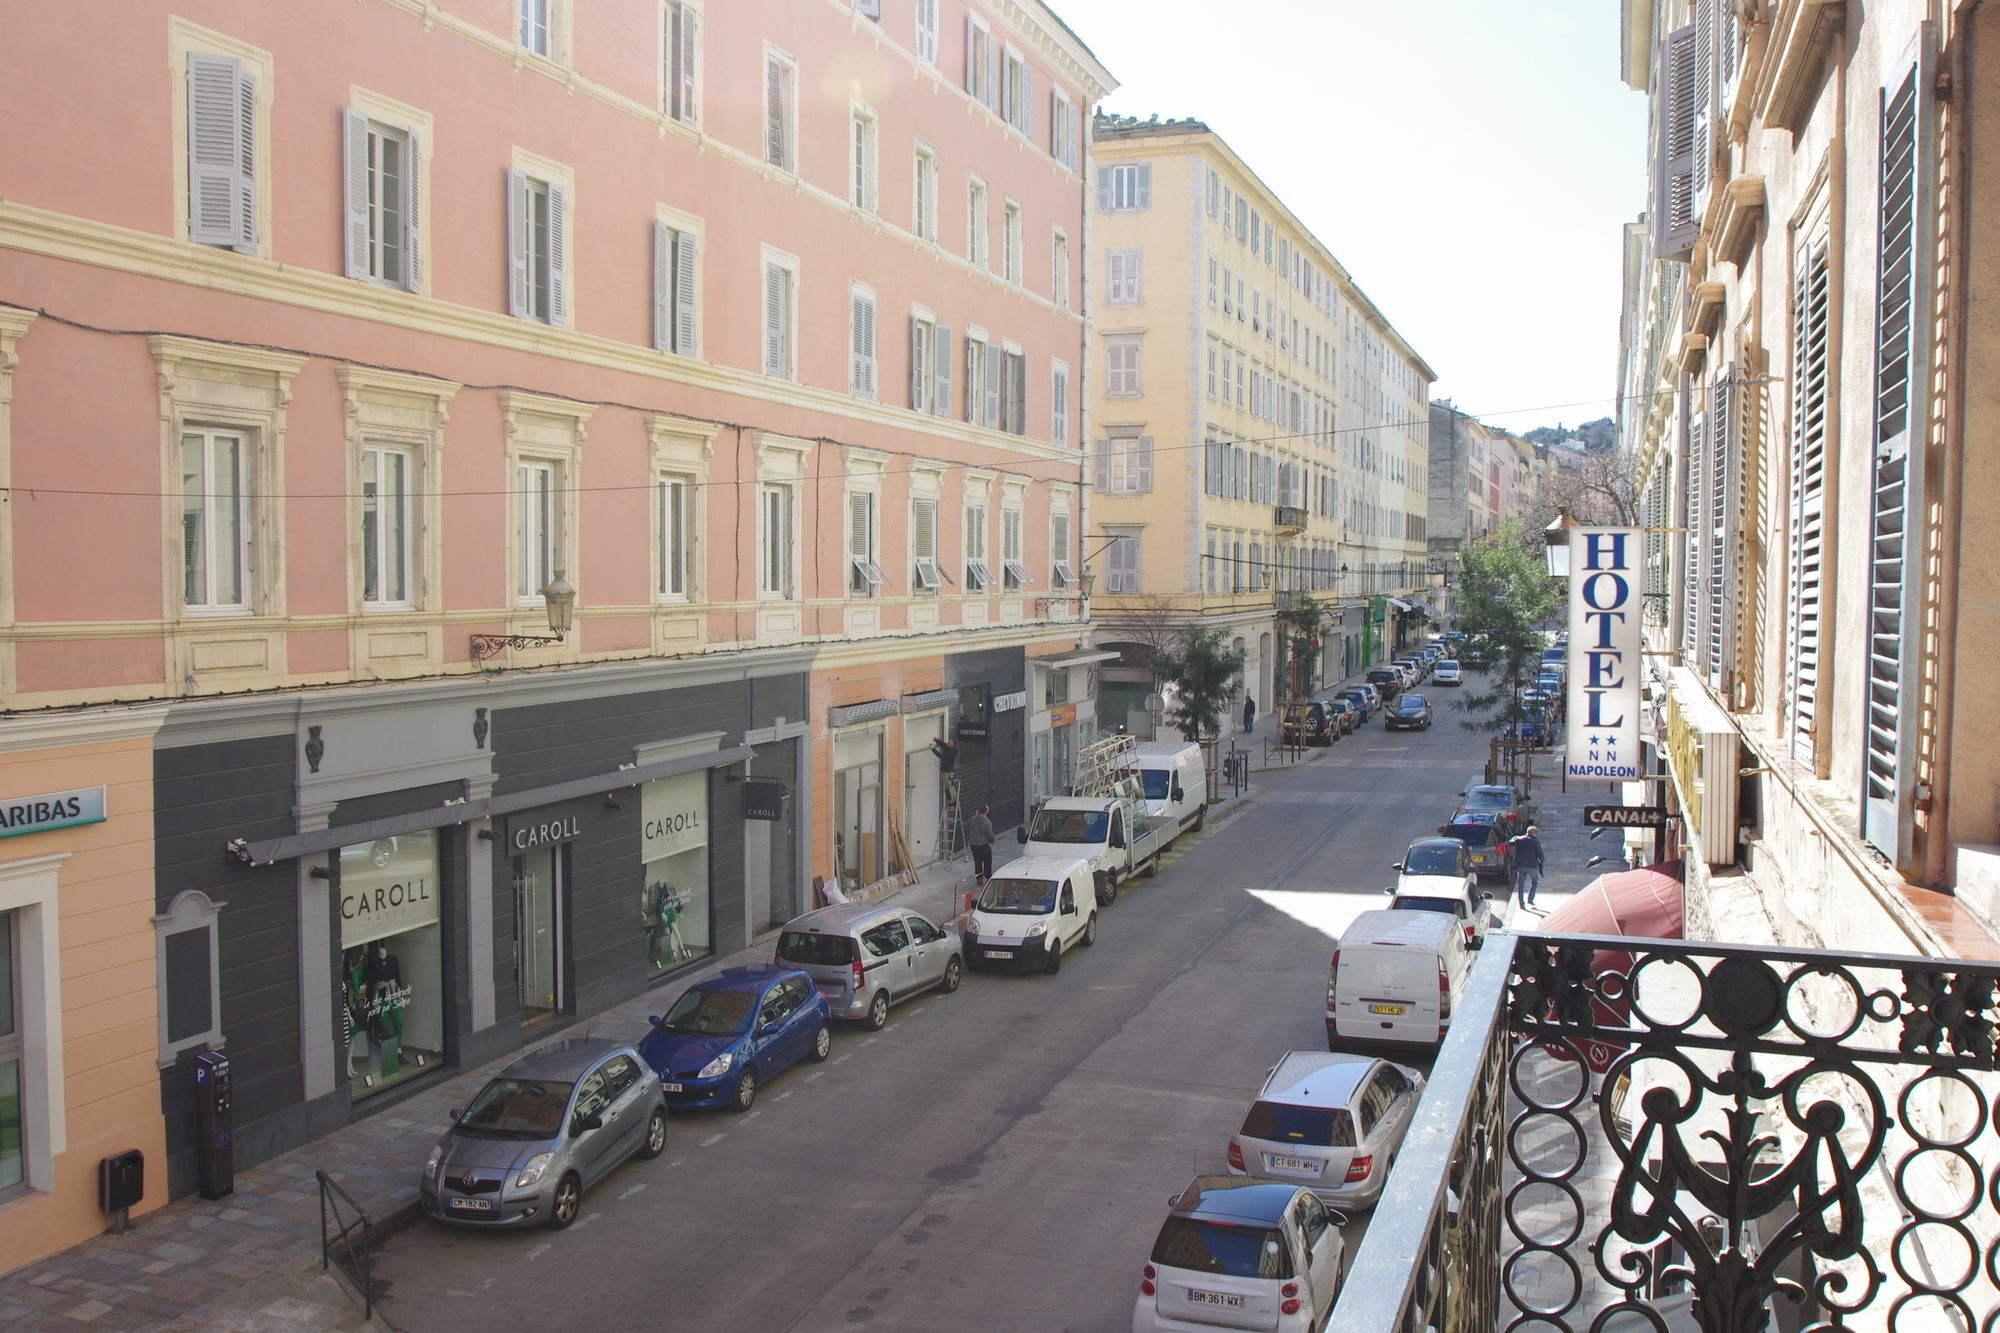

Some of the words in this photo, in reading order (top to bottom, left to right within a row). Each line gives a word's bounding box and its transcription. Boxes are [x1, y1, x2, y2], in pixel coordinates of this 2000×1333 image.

[1581, 533, 1631, 728] HOTEL
[1569, 765, 1636, 777] NAPOLEON
[747, 808, 777, 817] CAROLL
[1590, 809, 1660, 823] CANAL+
[516, 816, 580, 849] CAROLL
[645, 810, 699, 840] CAROLL
[341, 878, 429, 919] CAROLL
[197, 1068, 205, 1082] P
